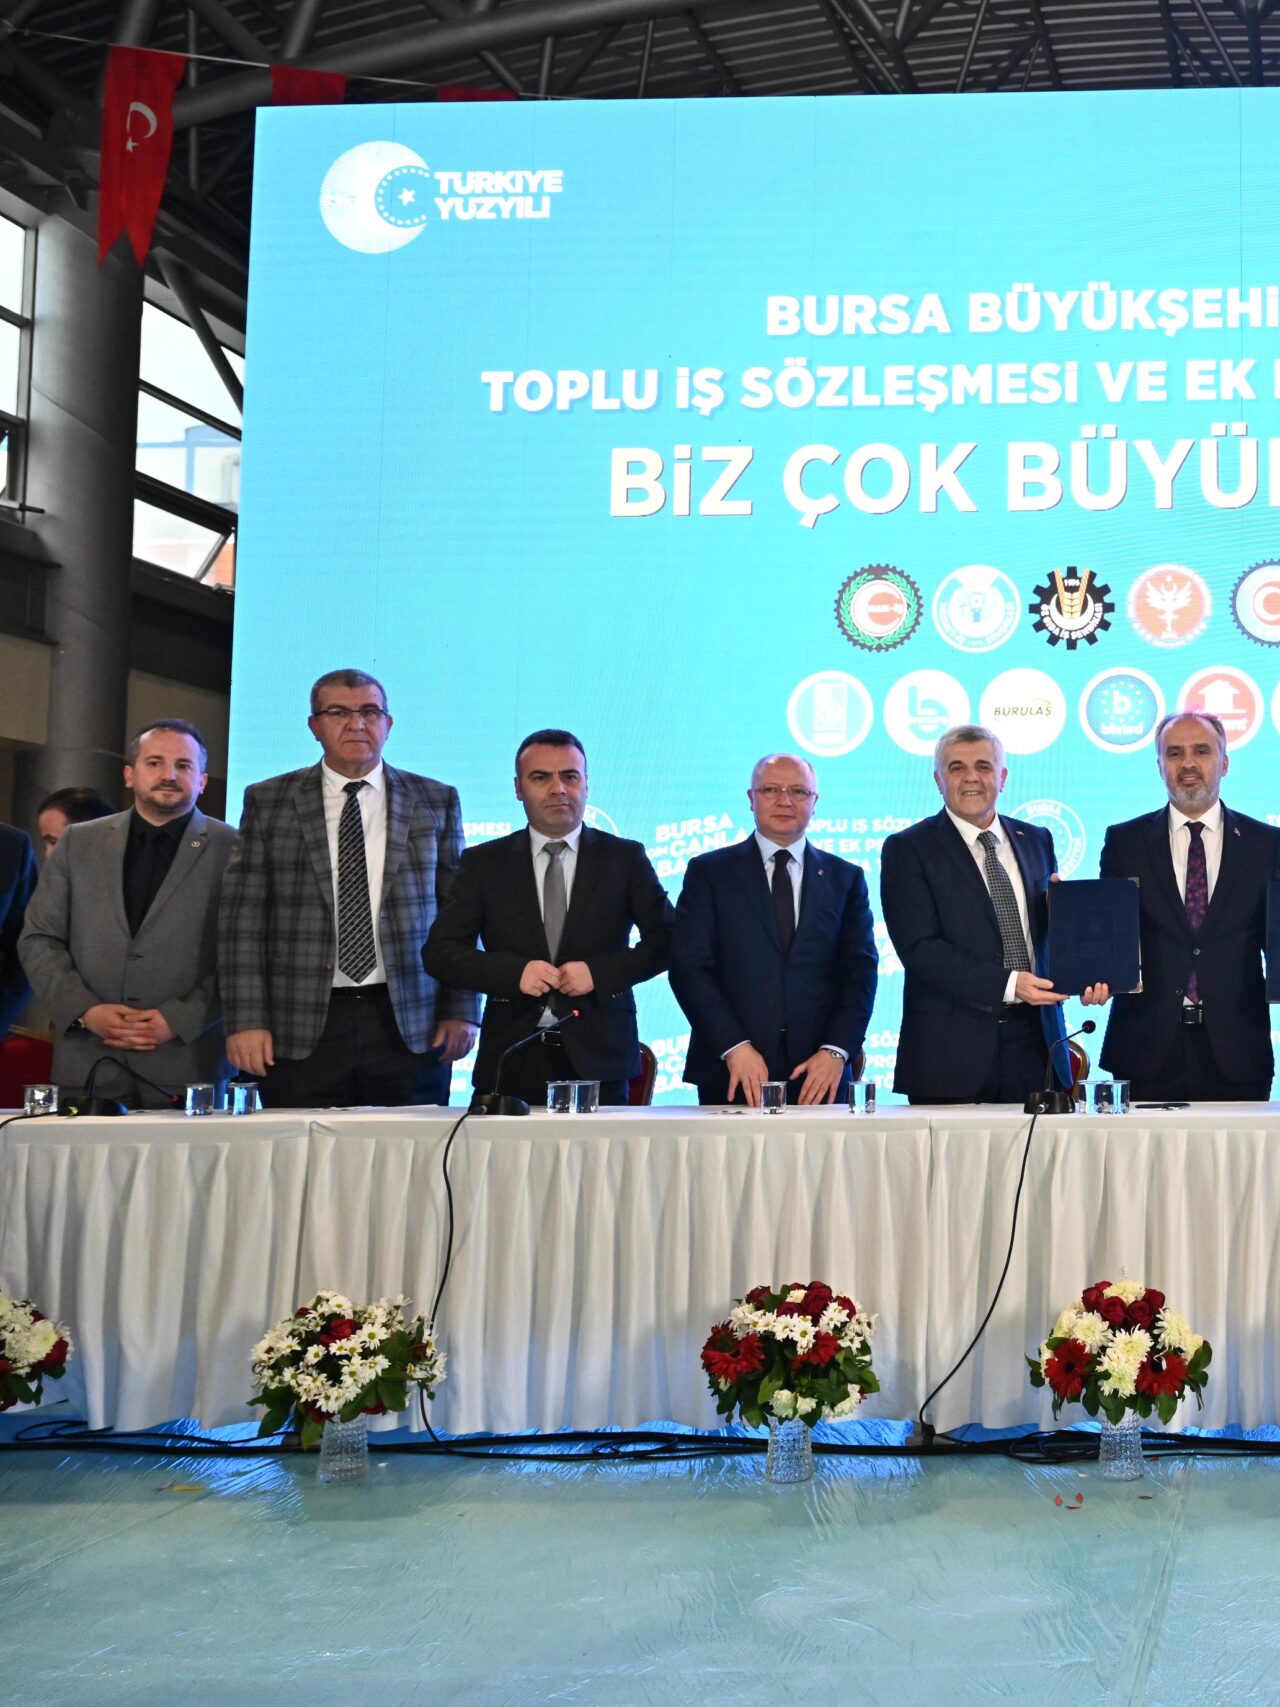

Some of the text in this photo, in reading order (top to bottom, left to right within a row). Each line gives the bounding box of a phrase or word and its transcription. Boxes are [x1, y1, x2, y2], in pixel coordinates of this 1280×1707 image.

[767, 294, 951, 335] BURSA
[481, 369, 658, 411] TOPLU
[676, 367, 724, 416] İŞ
[740, 357, 1078, 413] SÖZLEŞMESİ
[1096, 361, 1168, 402] VE
[1185, 359, 1257, 401] EK
[783, 443, 979, 529] ÇOK
[993, 705, 1052, 717] BURULAŞ
[655, 812, 734, 843] BURSA
[806, 818, 849, 833] OPLU
[839, 839, 862, 853] EK
